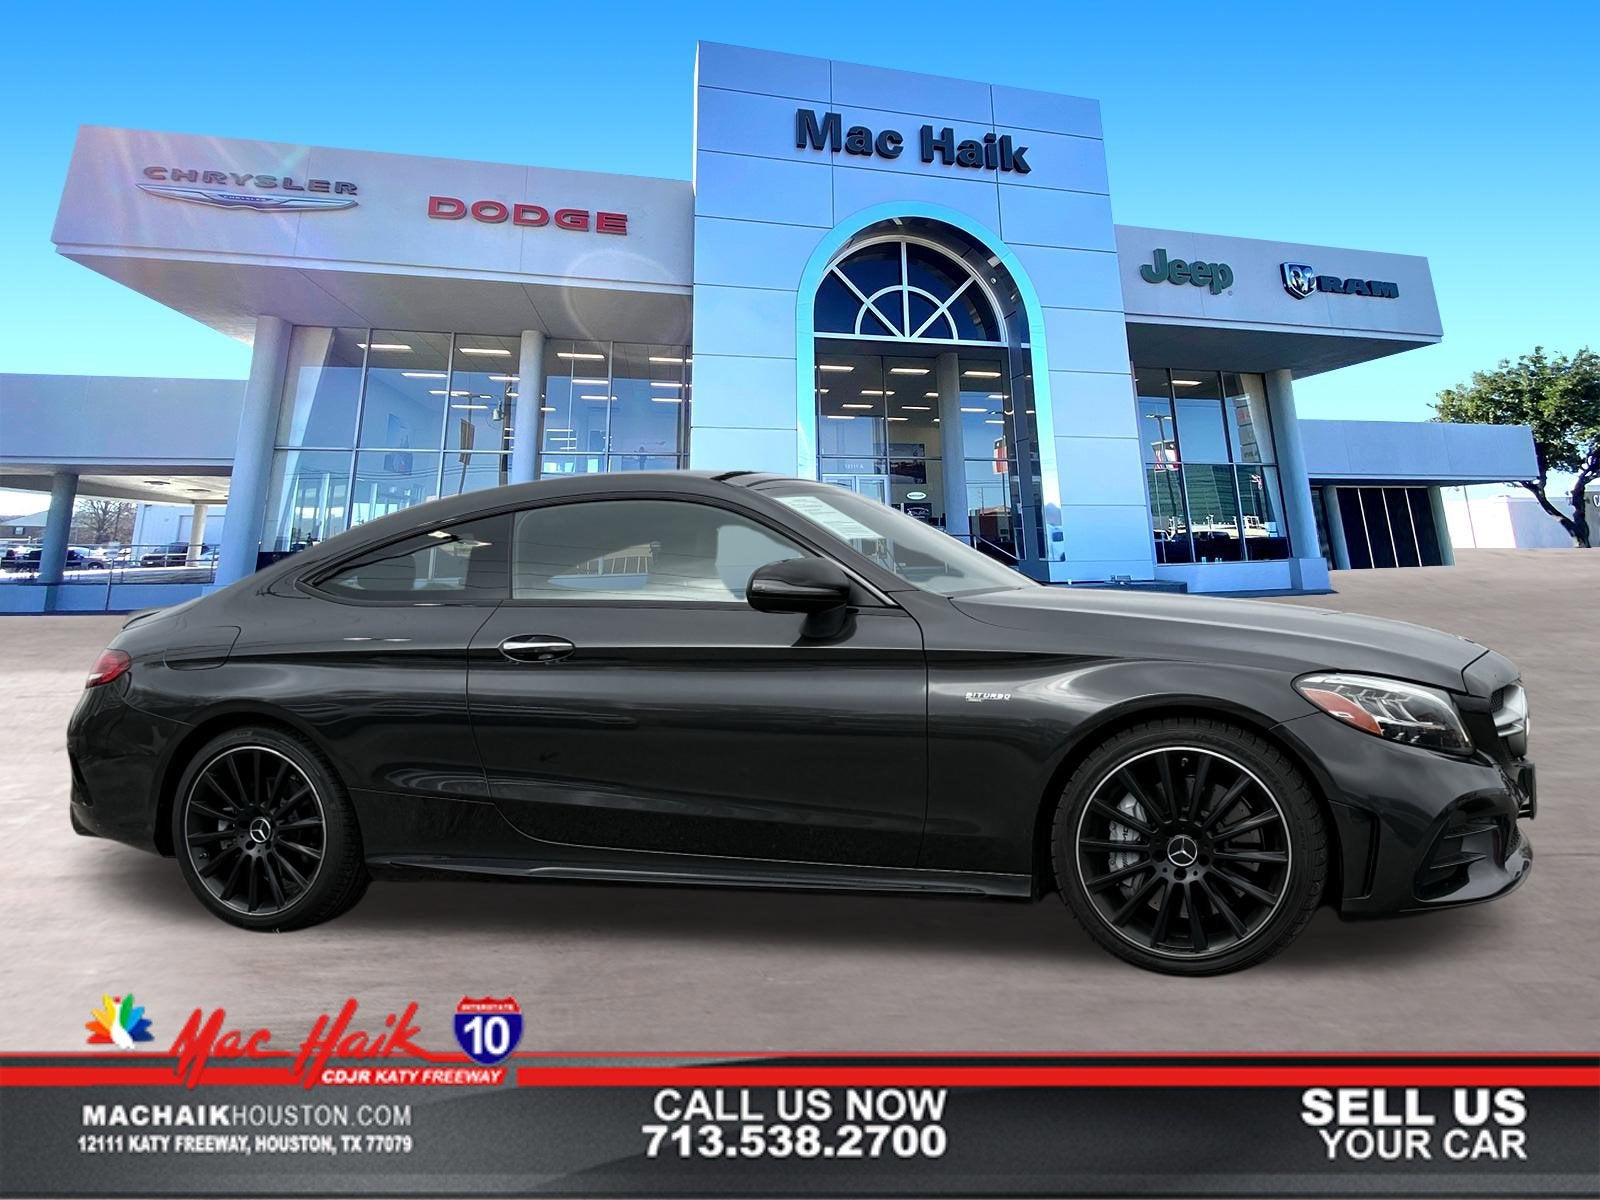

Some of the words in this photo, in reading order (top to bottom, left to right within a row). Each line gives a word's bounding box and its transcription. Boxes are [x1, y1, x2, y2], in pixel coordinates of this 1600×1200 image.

[796, 108, 904, 159] Mac
[920, 125, 1032, 174] Haik
[143, 166, 358, 196] CHRYSLER
[428, 196, 628, 236] DODGE
[1139, 248, 1234, 295] Jeep
[1316, 275, 1400, 299] RAM
